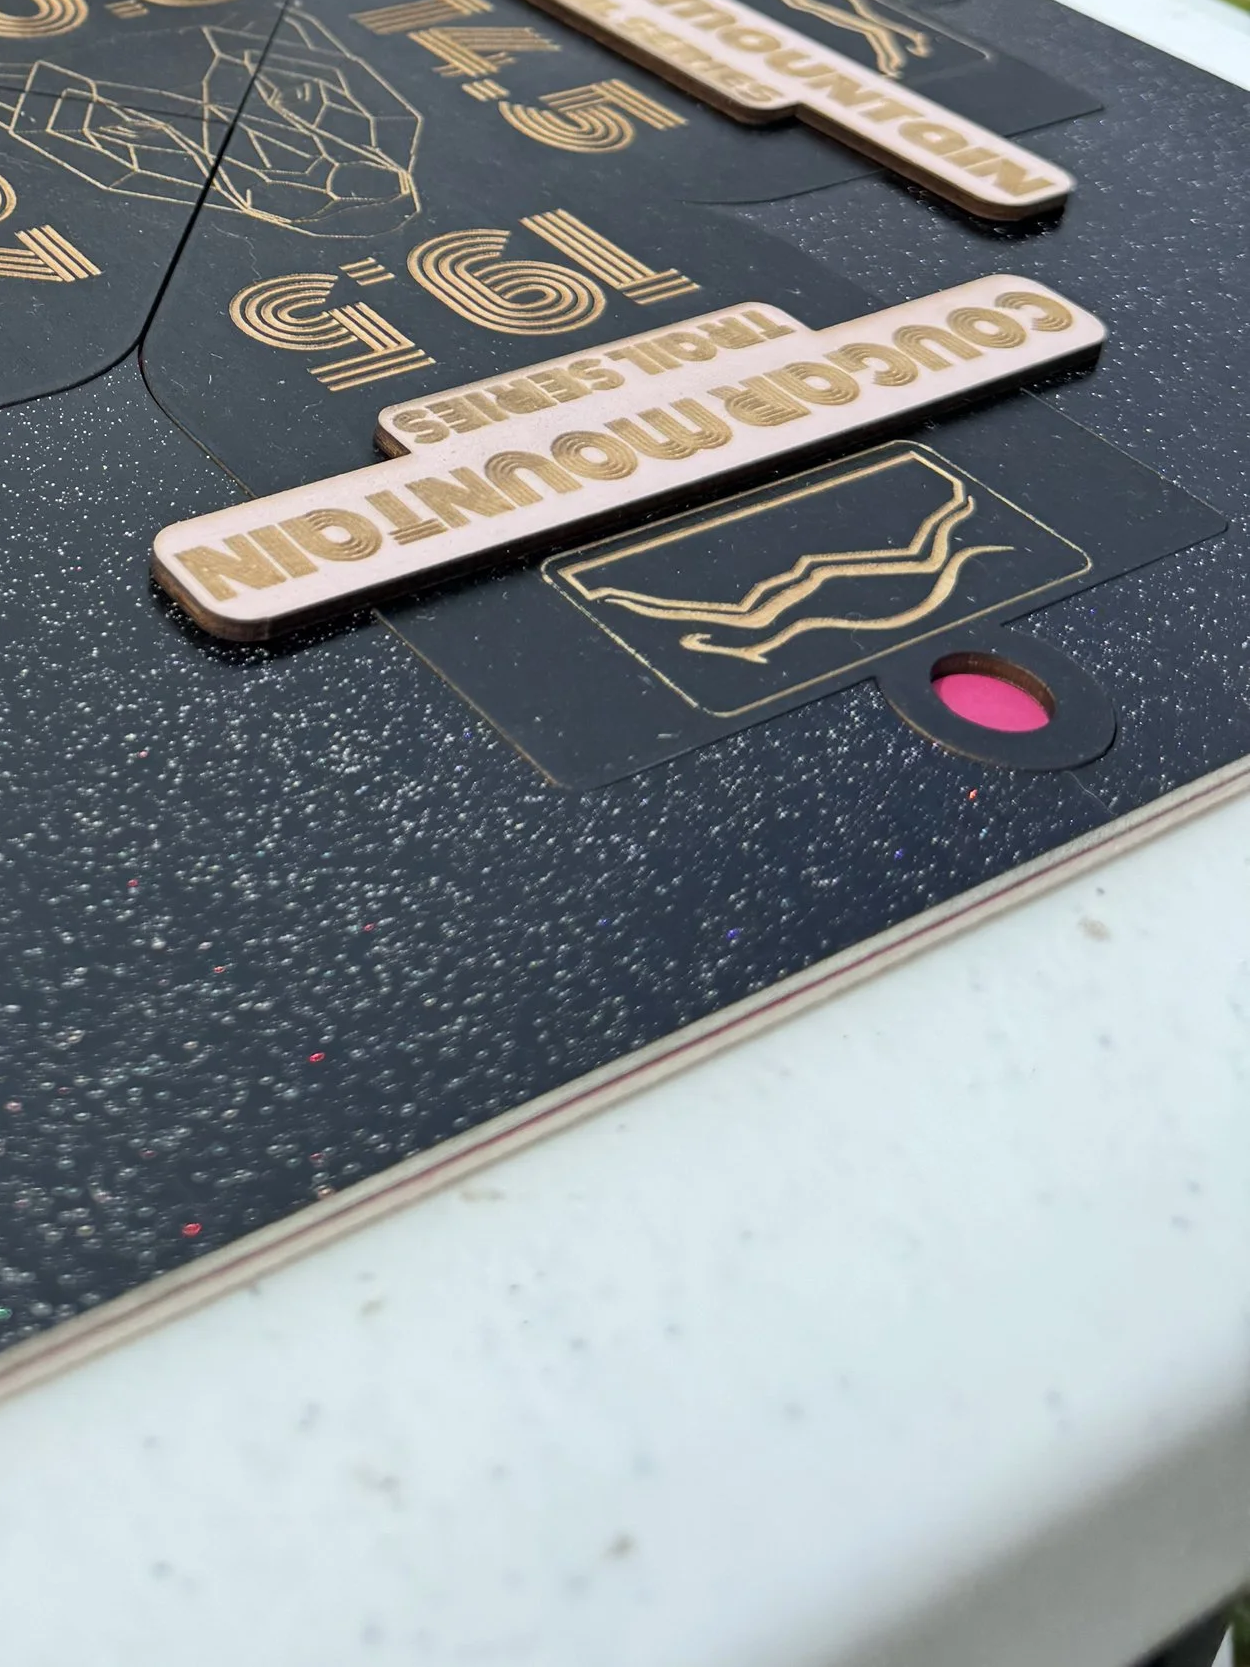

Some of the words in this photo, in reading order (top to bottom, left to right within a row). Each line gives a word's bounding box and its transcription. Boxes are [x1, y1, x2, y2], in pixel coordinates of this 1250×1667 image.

[228, 208, 702, 392] 19.5
[605, 308, 797, 375] TRAIL
[707, 290, 1074, 427] COUGAR
[392, 357, 625, 444] SERIES
[173, 396, 734, 602] MOUNTAIN
